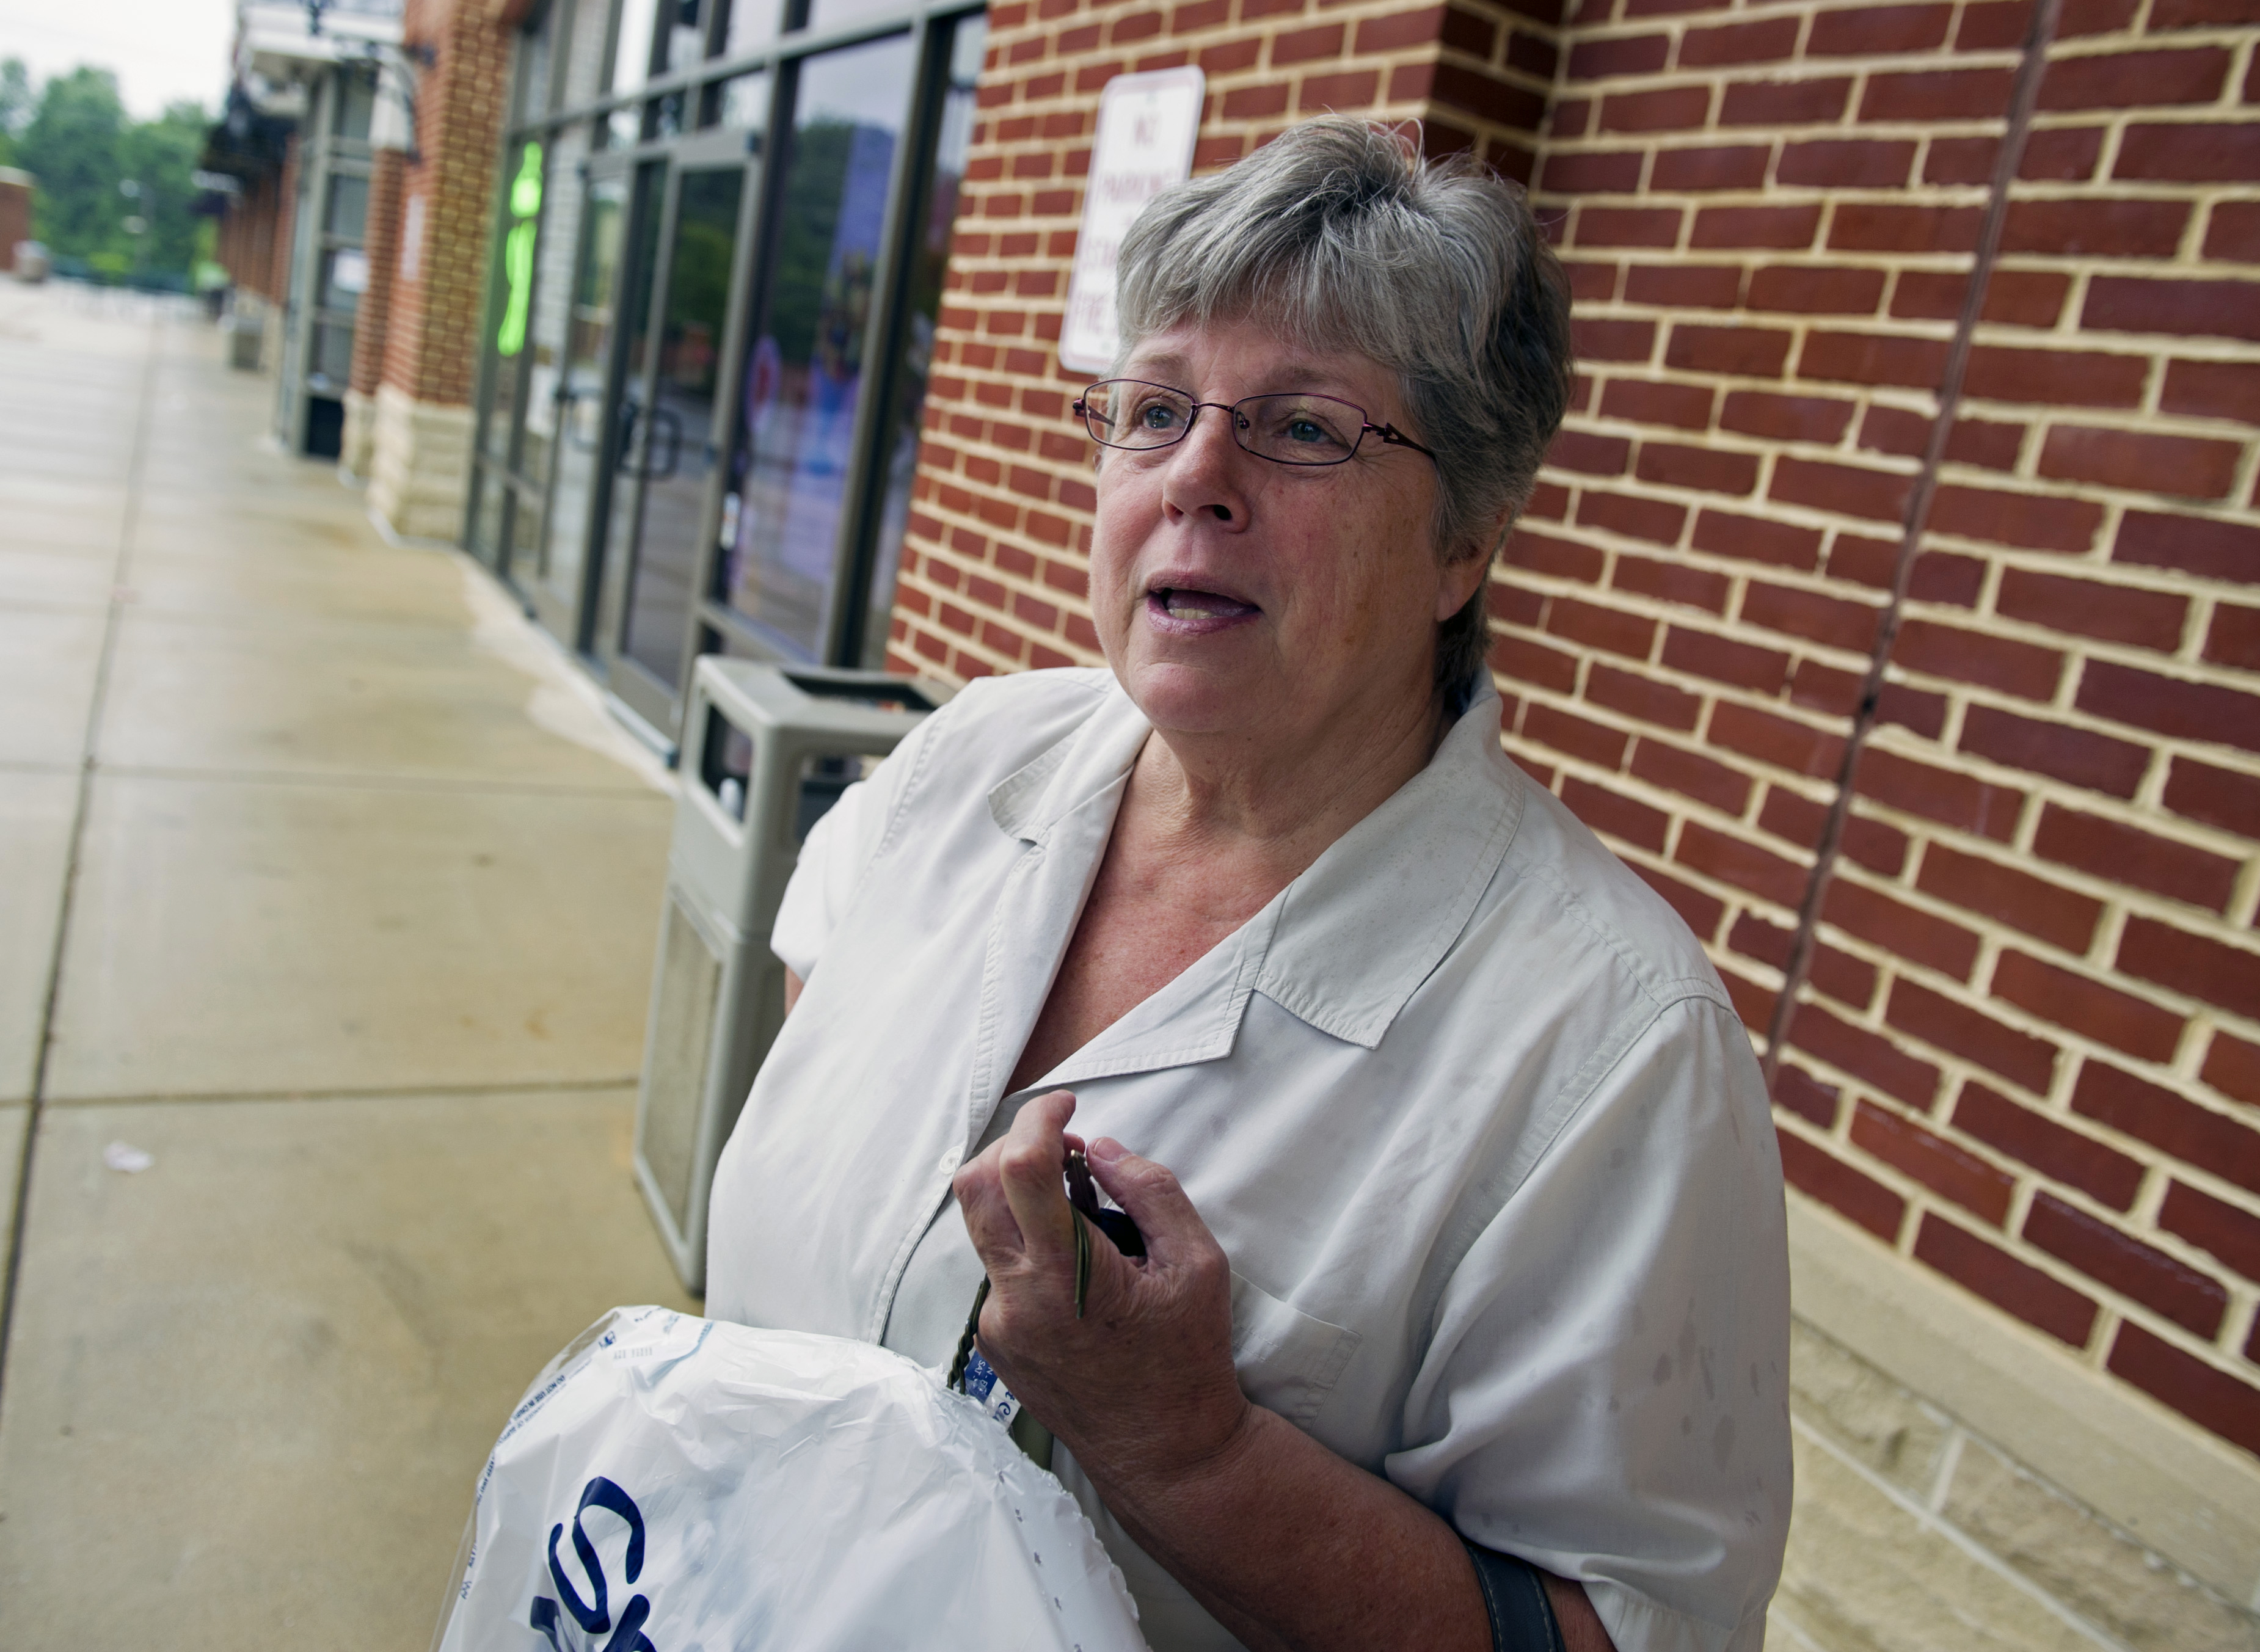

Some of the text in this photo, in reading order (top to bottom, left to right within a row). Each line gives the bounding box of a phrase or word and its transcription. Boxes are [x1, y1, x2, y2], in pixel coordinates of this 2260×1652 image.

[975, 1360, 986, 1375] SAT
[545, 1381, 557, 1393] NOT
[534, 1391, 546, 1402] USE
